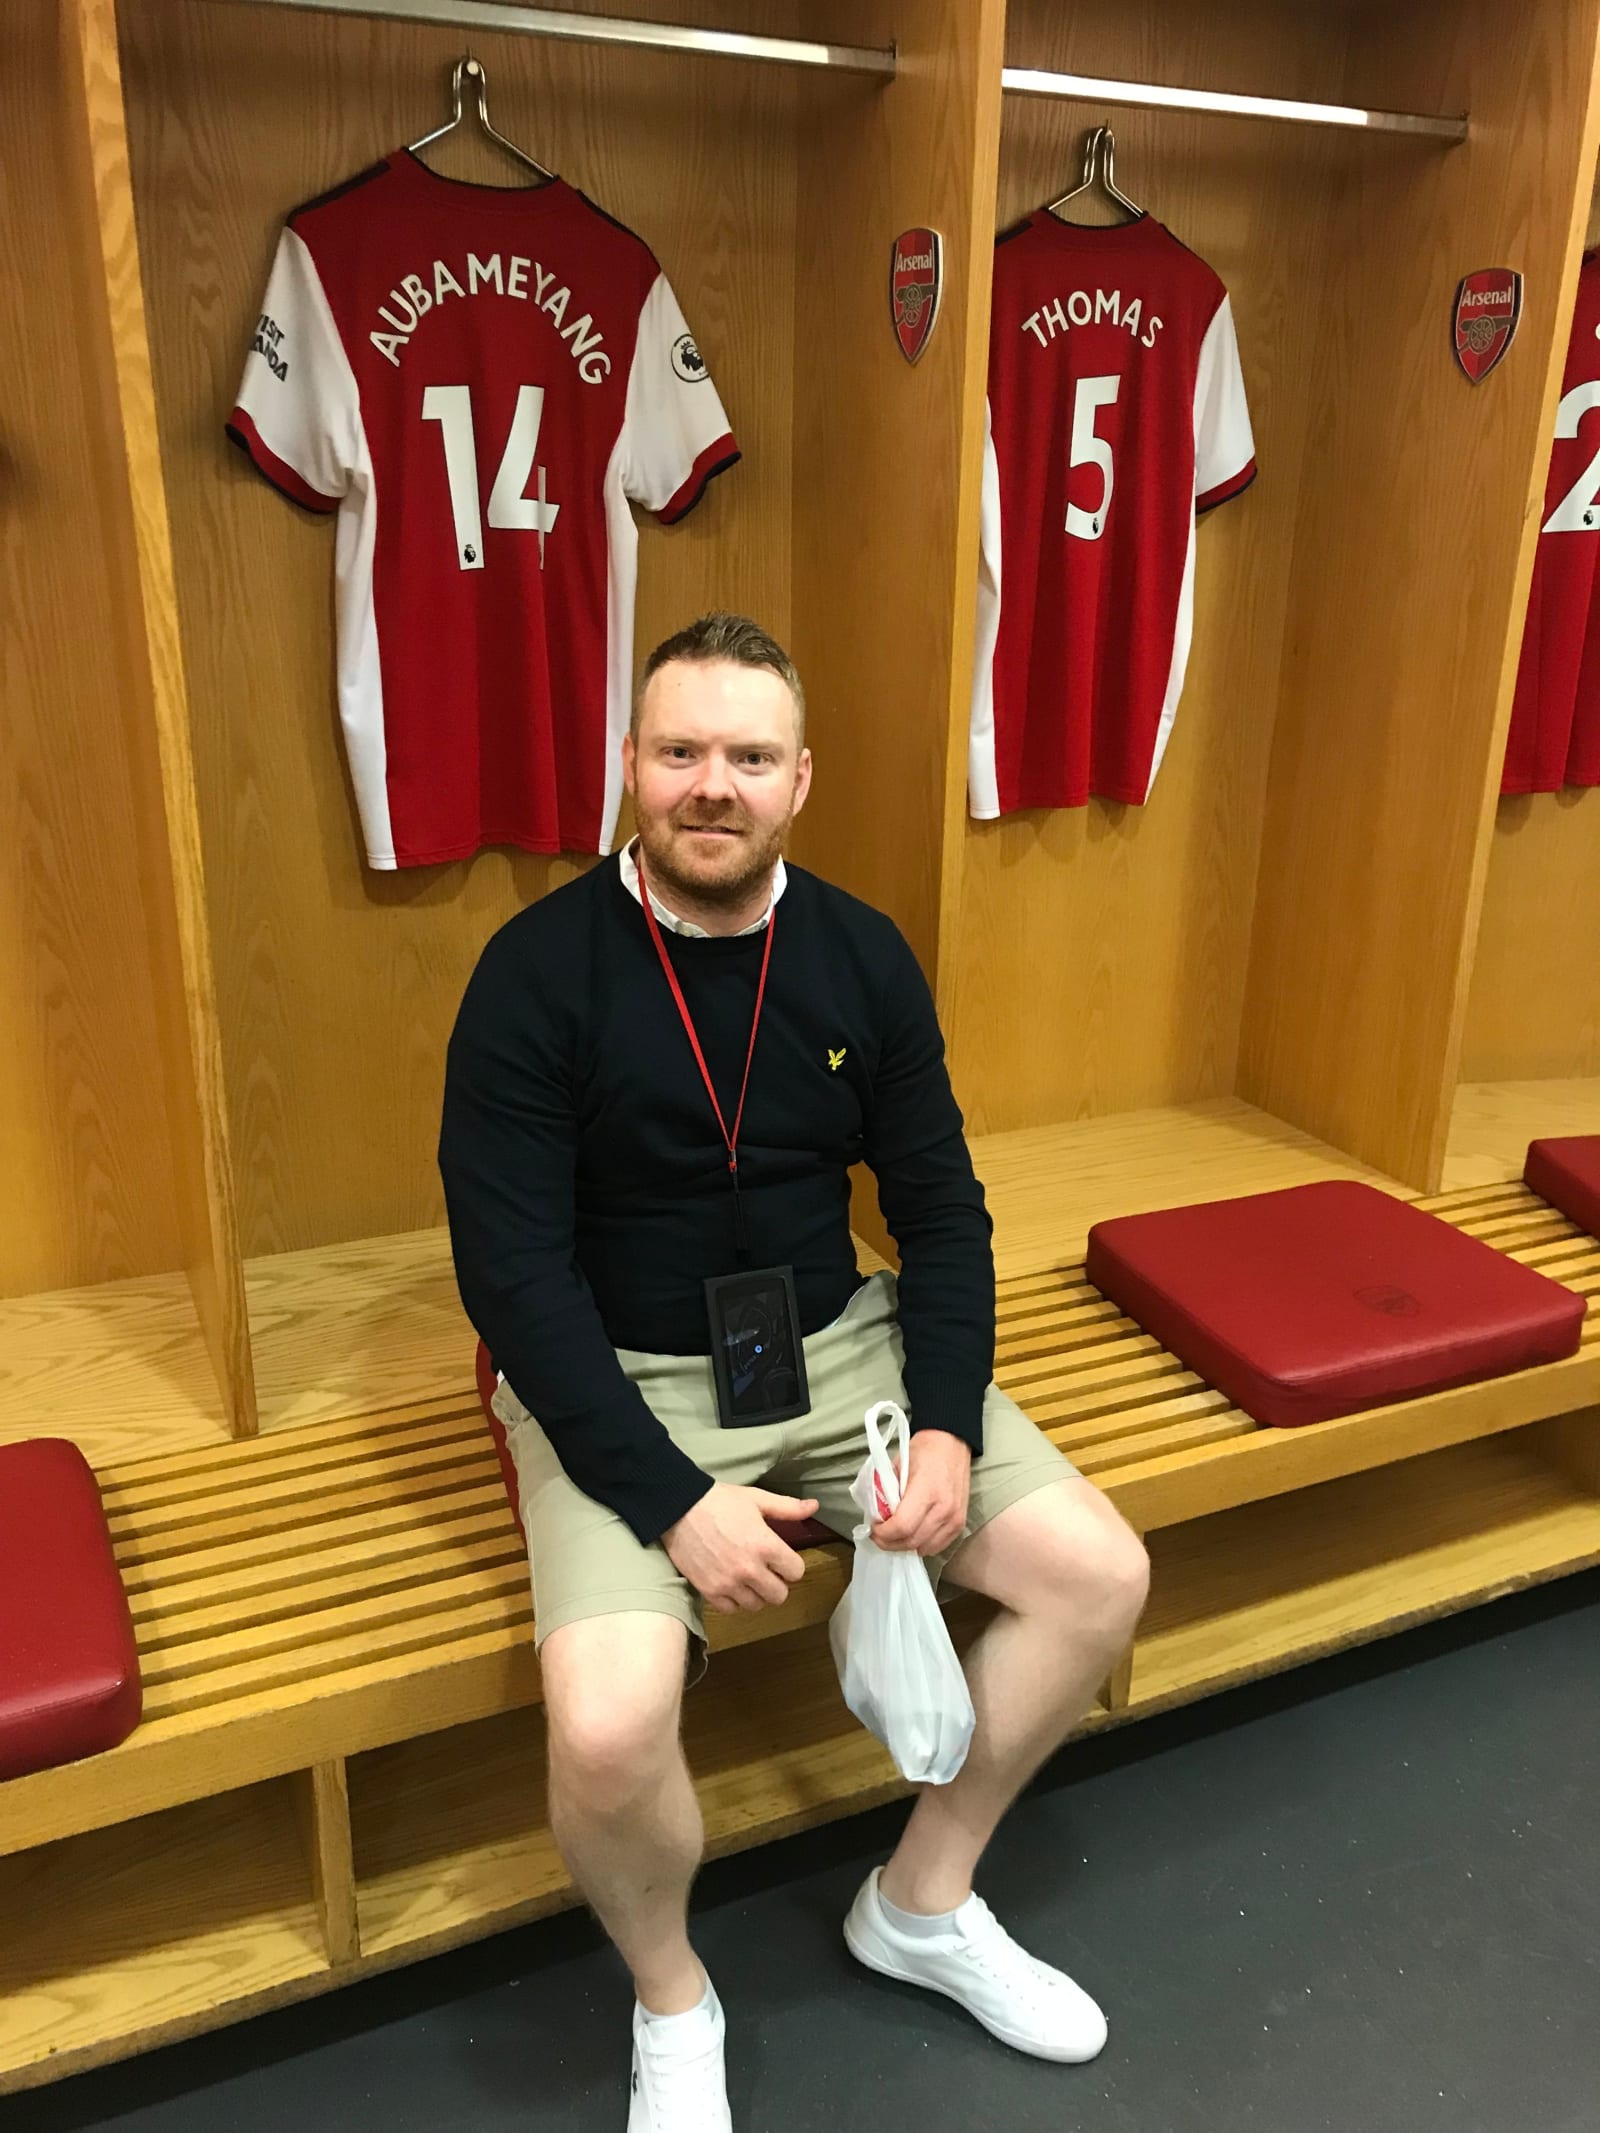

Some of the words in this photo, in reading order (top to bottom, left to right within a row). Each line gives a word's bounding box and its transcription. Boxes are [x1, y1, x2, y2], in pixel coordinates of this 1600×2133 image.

[896, 249, 932, 272] Arsenal
[369, 252, 612, 385] AUBAMEYANG
[1020, 288, 1164, 348] THOMAS
[1461, 286, 1511, 307] Arsenal
[249, 334, 288, 382] ANDA
[421, 385, 560, 570] 14
[1064, 374, 1121, 541] 5
